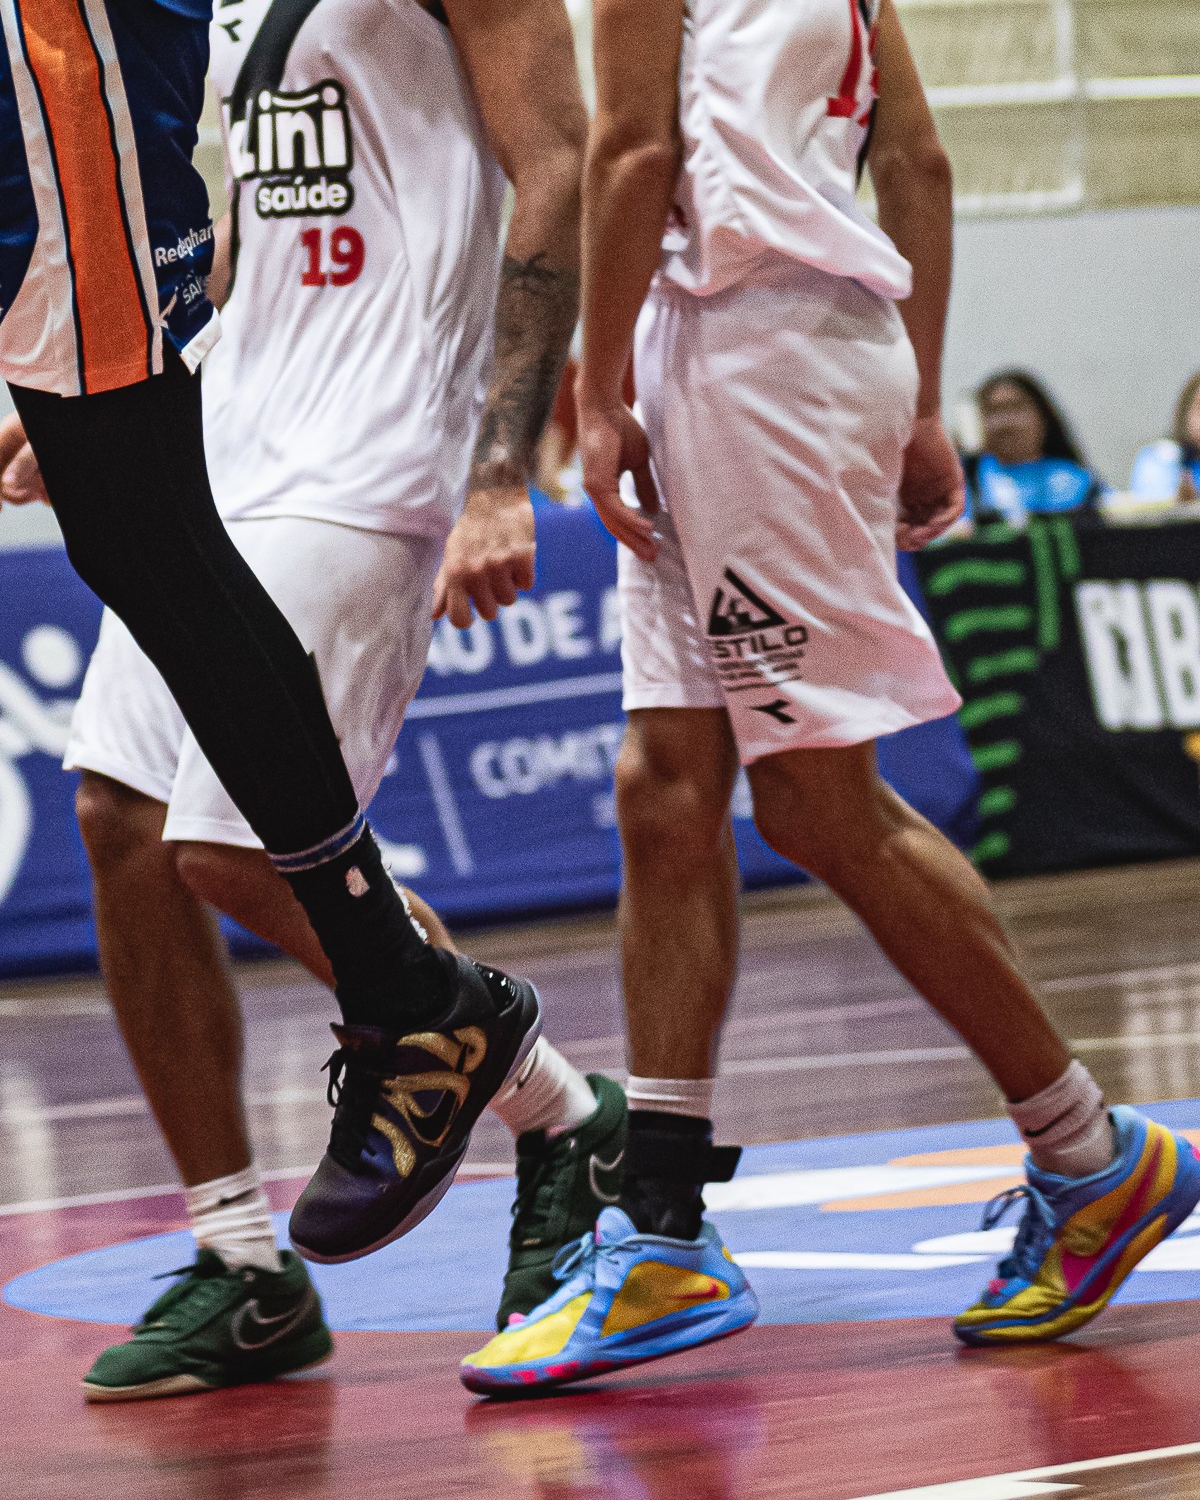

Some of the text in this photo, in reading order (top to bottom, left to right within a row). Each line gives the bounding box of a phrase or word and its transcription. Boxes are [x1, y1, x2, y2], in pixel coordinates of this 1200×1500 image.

[258, 175, 348, 213] saúde
[300, 226, 366, 288] 19
[502, 590, 594, 667] DE
[712, 624, 808, 658] STILO
